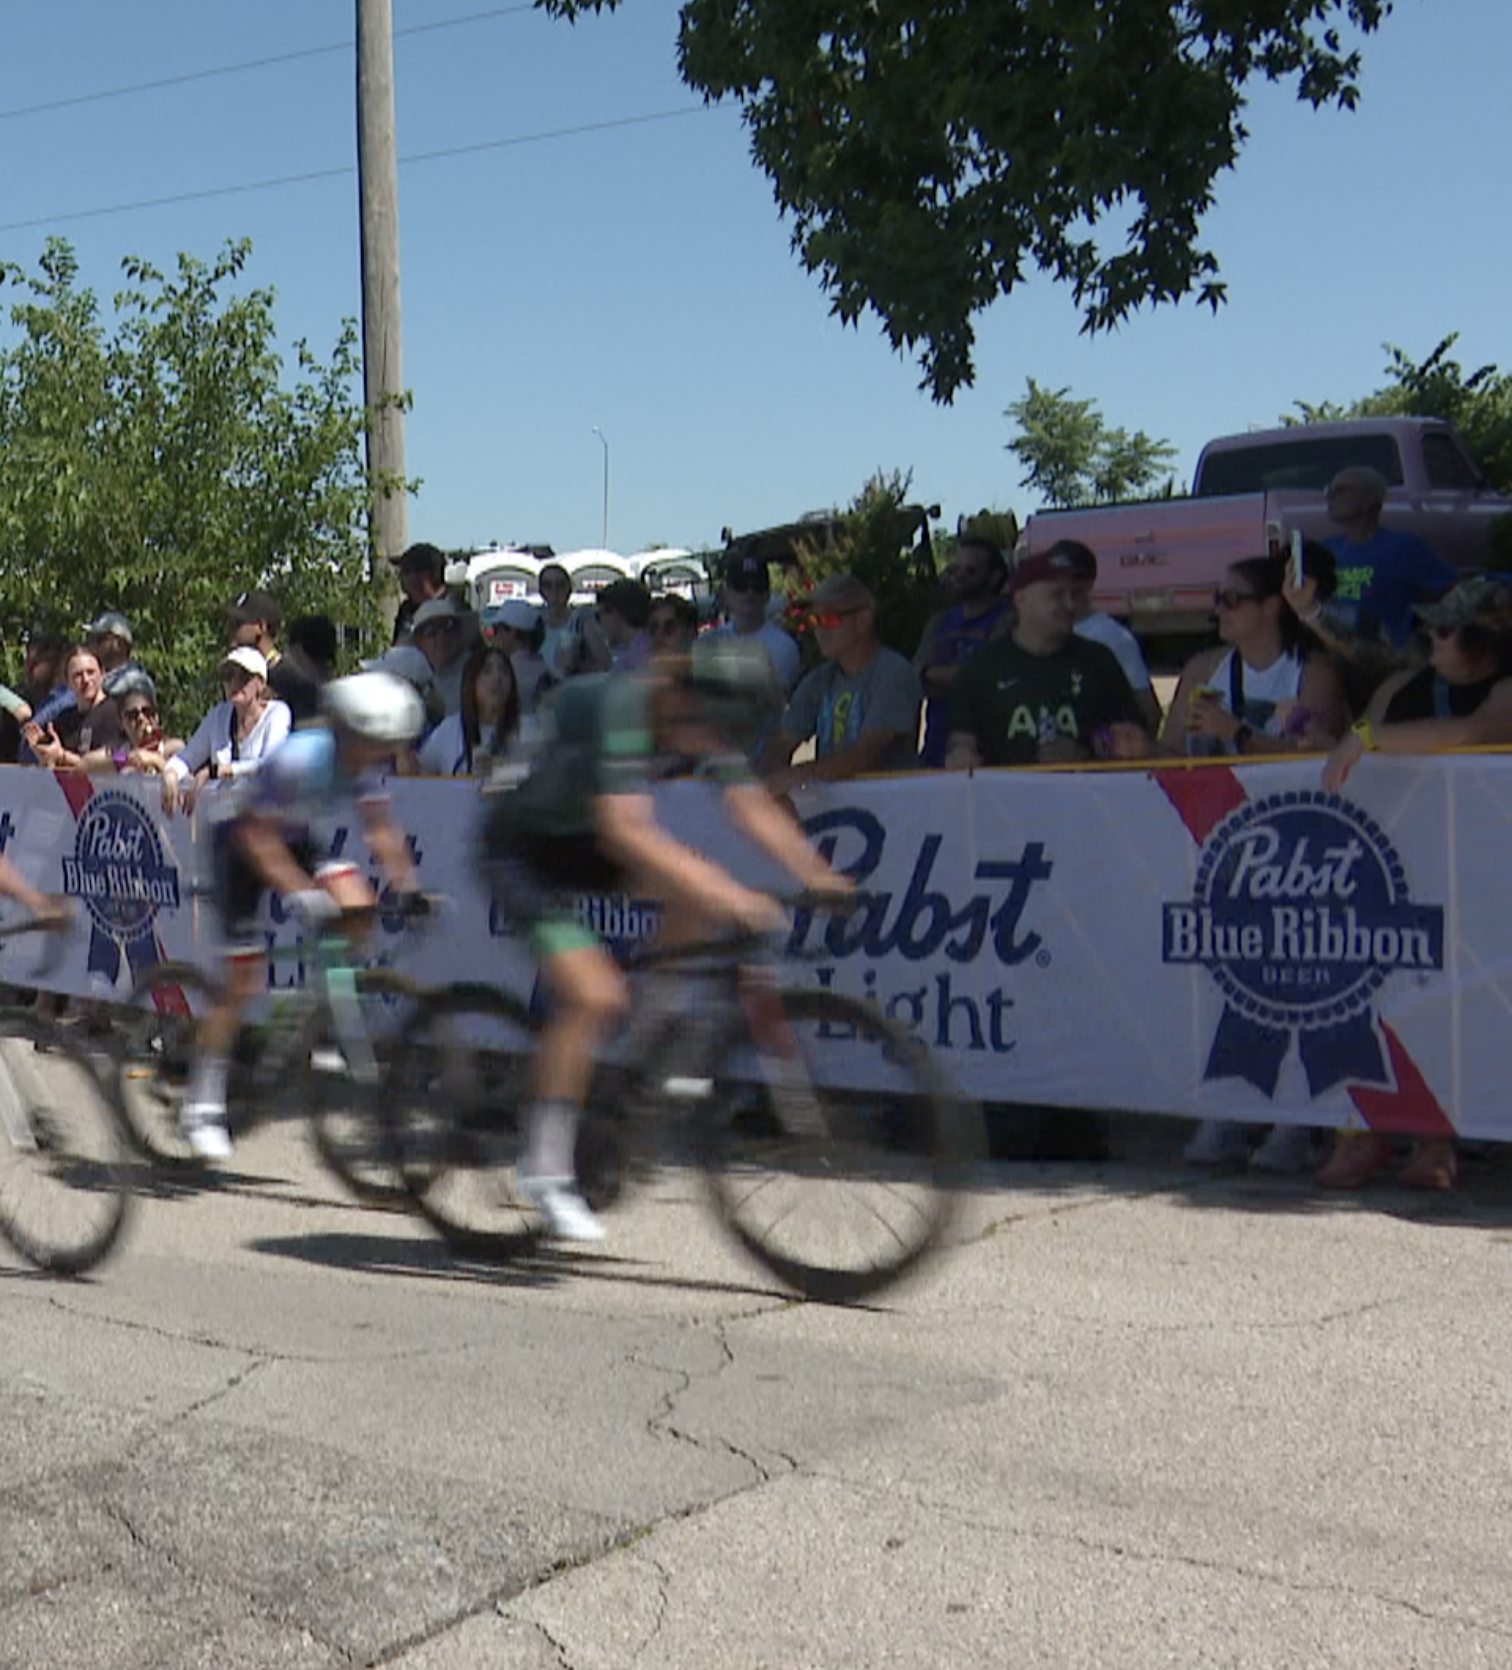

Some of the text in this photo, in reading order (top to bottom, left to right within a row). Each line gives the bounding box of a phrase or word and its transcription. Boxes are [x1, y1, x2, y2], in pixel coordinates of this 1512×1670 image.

[89, 811, 144, 860] Pabst
[65, 860, 176, 903] Blue Ribbon
[1228, 825, 1363, 898] Pabst
[788, 807, 1054, 967] Pabst
[575, 892, 659, 940] Ribbo
[1168, 905, 1434, 965] Blue Ribbon
[1262, 967, 1331, 985] BEER
